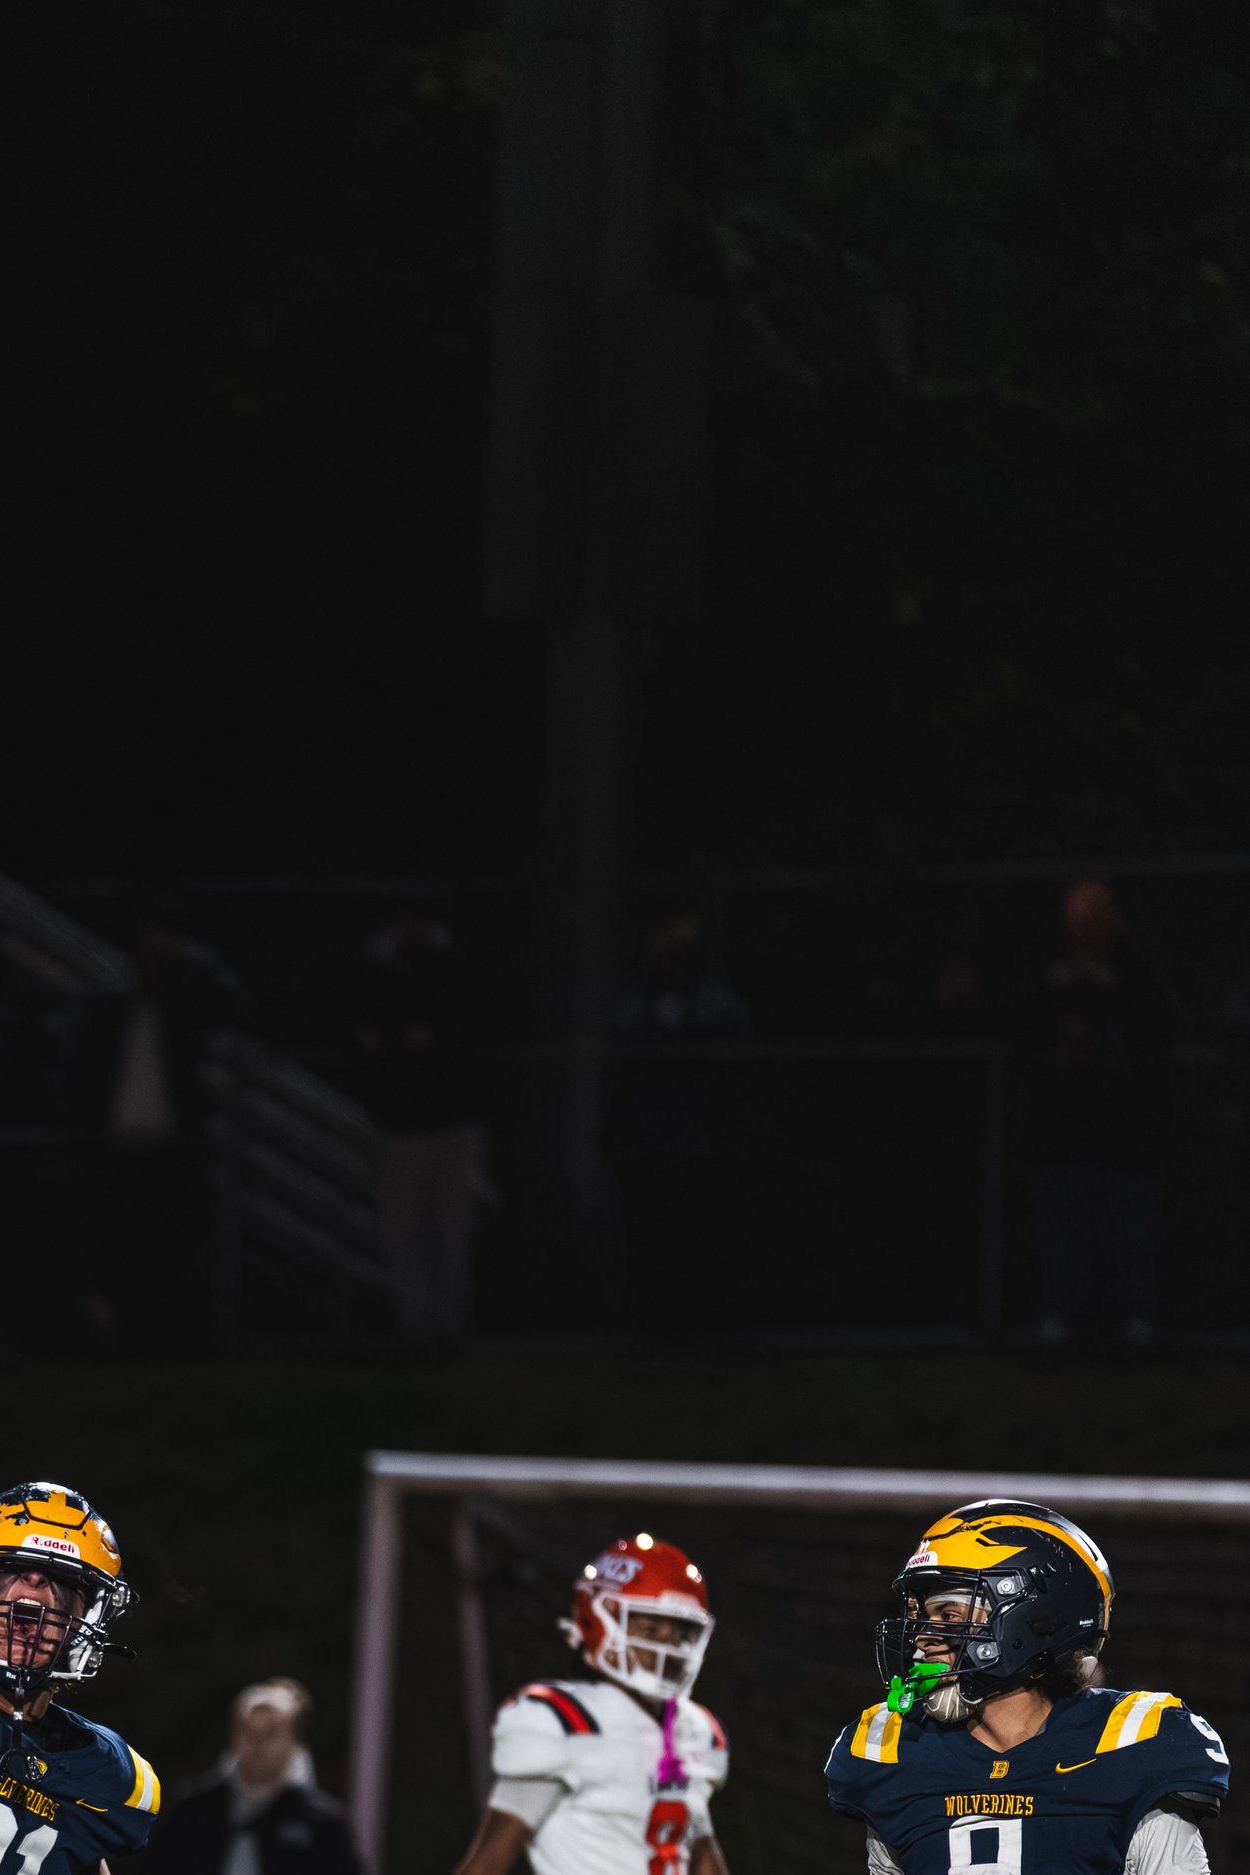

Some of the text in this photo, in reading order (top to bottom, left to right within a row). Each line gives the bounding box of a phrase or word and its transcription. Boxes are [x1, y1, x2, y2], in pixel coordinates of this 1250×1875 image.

[1189, 1713, 1230, 1766] 9
[989, 1760, 1011, 1779] B
[944, 1793, 1034, 1818] WOLVERINES
